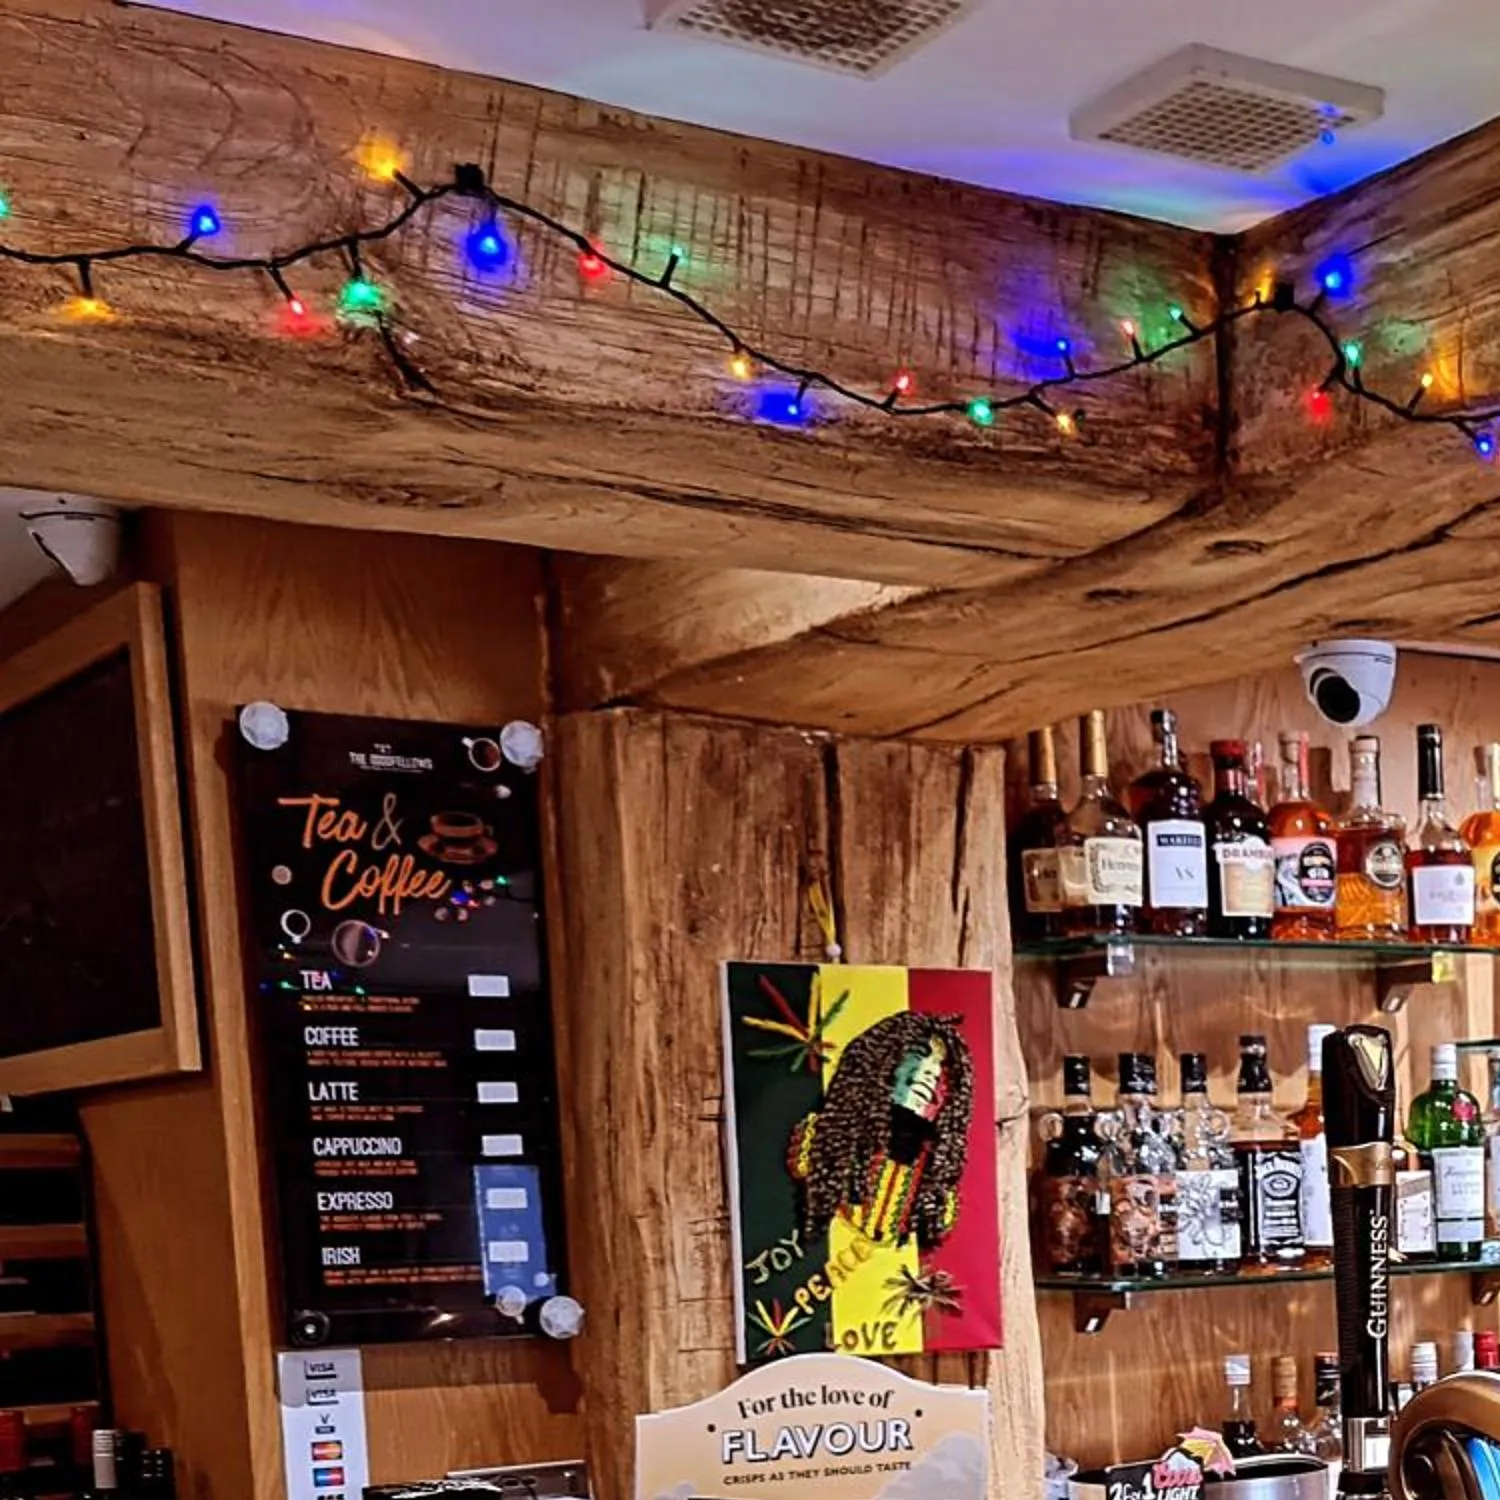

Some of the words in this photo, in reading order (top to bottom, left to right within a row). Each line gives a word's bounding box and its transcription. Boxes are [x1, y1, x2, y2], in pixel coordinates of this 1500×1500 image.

[277, 793, 368, 849] Tea
[371, 792, 402, 851] &
[321, 849, 452, 916] Coffee
[301, 970, 332, 991] TEA
[304, 1026, 360, 1047] COFFEE
[308, 1081, 360, 1101] LATTE
[313, 1136, 402, 1156] CAPPUCCINO
[317, 1191, 394, 1210] EXPRESSO
[321, 1246, 361, 1265] IRISH
[745, 1229, 804, 1284] JOY
[1366, 1214, 1388, 1339] GUINNESS
[825, 1320, 899, 1351] LOVE
[738, 1398, 775, 1420] For
[777, 1386, 817, 1412] the
[820, 1384, 867, 1407] love
[869, 1389, 896, 1410] of
[721, 1417, 913, 1463] FLAVOUR
[723, 1472, 766, 1486] CRISPS
[769, 1470, 785, 1483] AS
[788, 1468, 820, 1481] THEY
[823, 1463, 871, 1478] SHOULD
[875, 1460, 912, 1473] TASTE
